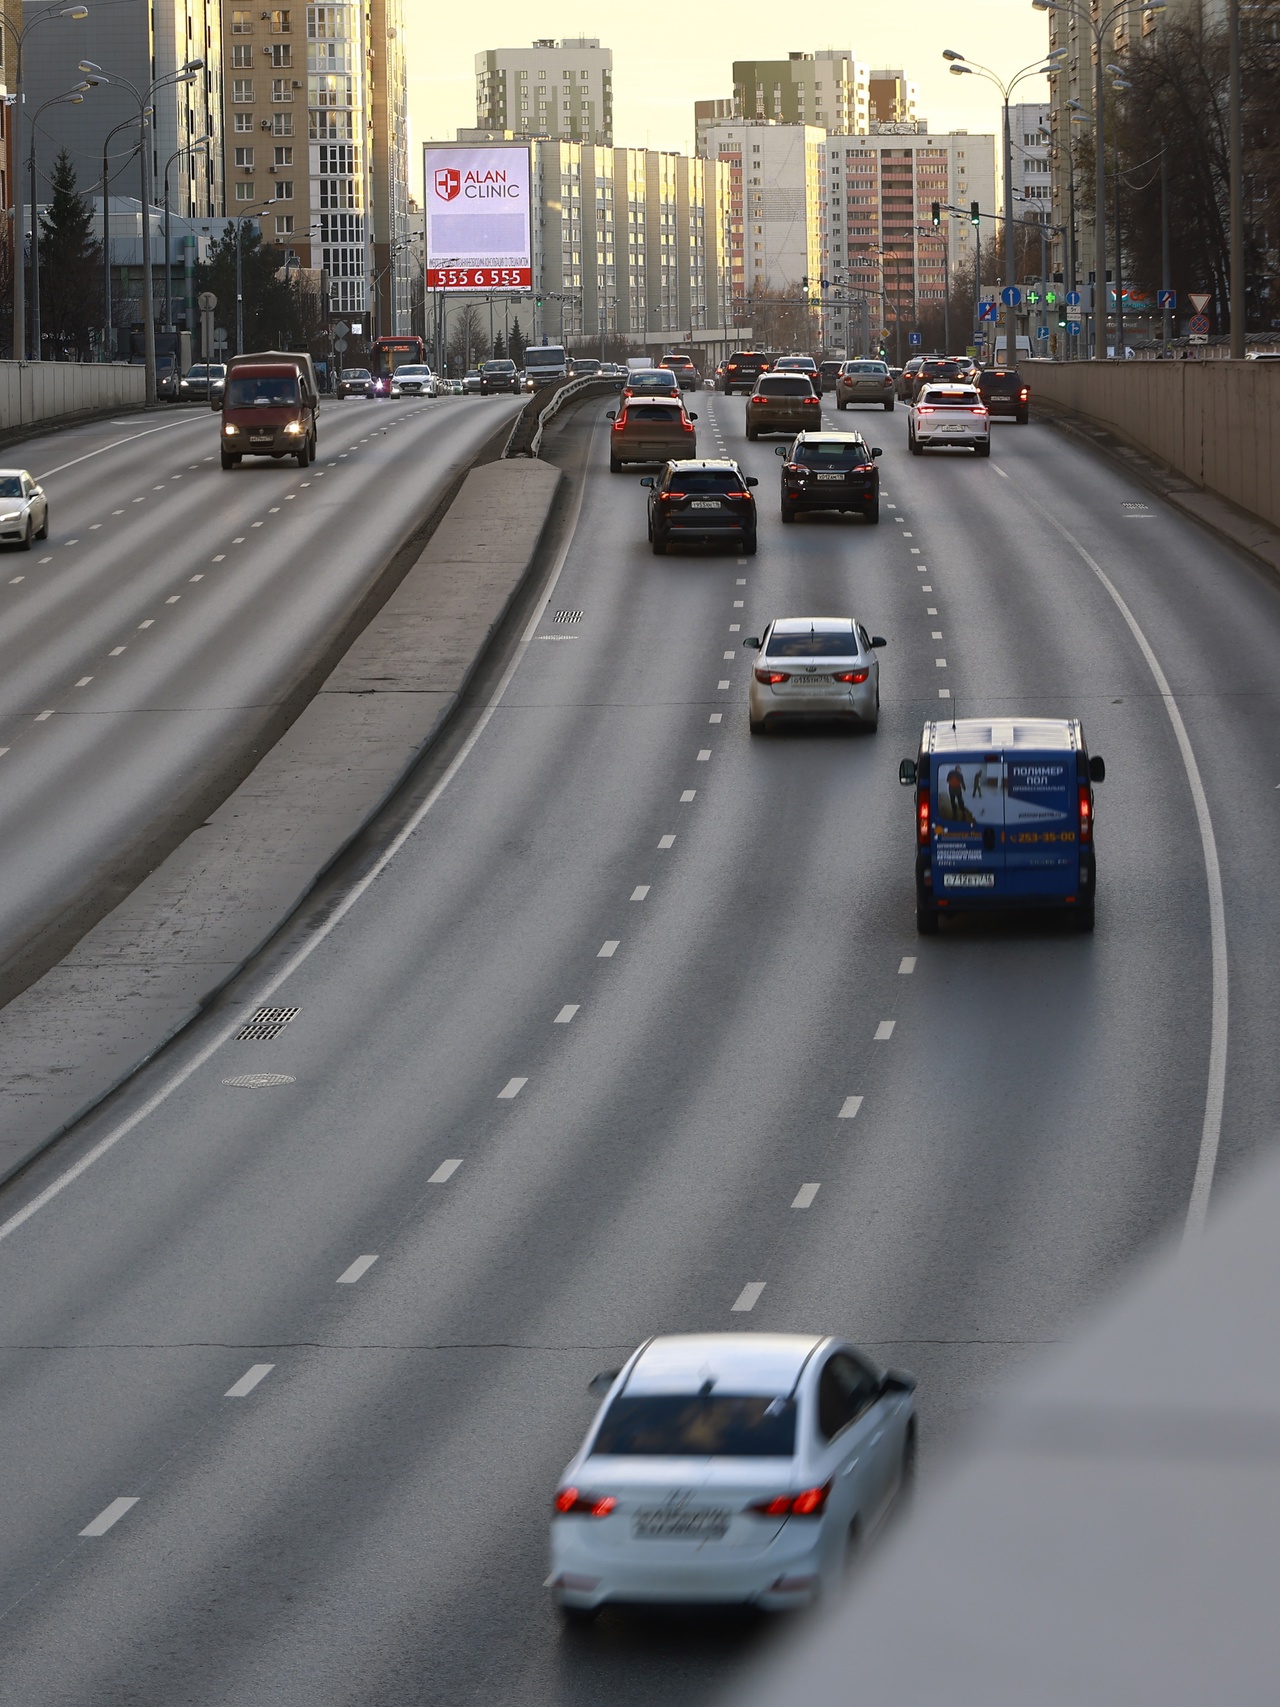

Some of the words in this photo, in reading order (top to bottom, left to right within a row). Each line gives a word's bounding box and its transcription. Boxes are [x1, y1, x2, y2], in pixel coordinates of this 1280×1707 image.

[464, 170, 506, 183] ALAN
[464, 184, 520, 198] CLINIC
[438, 270, 468, 285] 555
[474, 270, 484, 285] 6
[491, 270, 521, 284] 555
[1013, 766, 1064, 776] ПОЛИМЕР
[1026, 776, 1048, 785] ПОЛ
